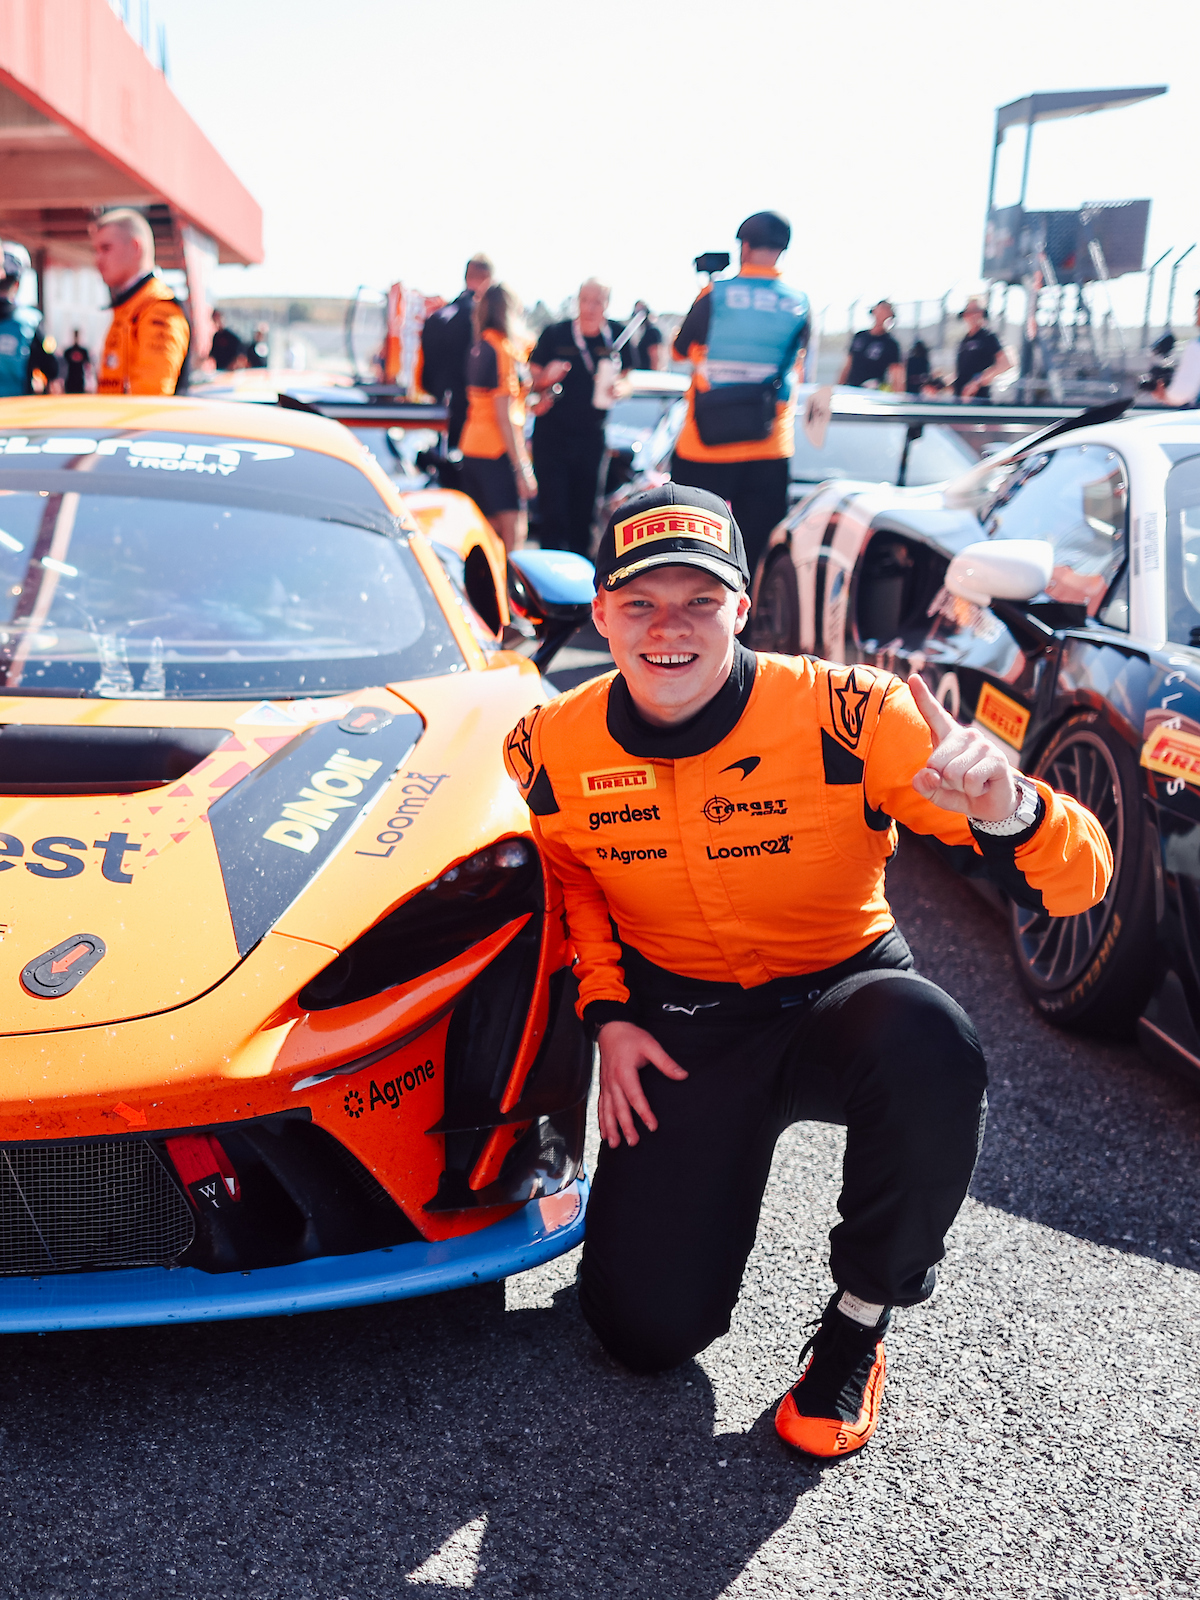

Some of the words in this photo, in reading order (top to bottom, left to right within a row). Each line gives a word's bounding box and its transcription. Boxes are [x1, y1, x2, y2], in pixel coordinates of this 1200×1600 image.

[128, 456, 237, 476] TROPHY
[622, 511, 723, 547] PIRELLI
[587, 769, 648, 791] PIRELLI
[588, 804, 661, 831] gardest
[711, 799, 787, 814] TARGET
[610, 845, 668, 865] Agrone
[369, 1059, 436, 1112] Agrone
